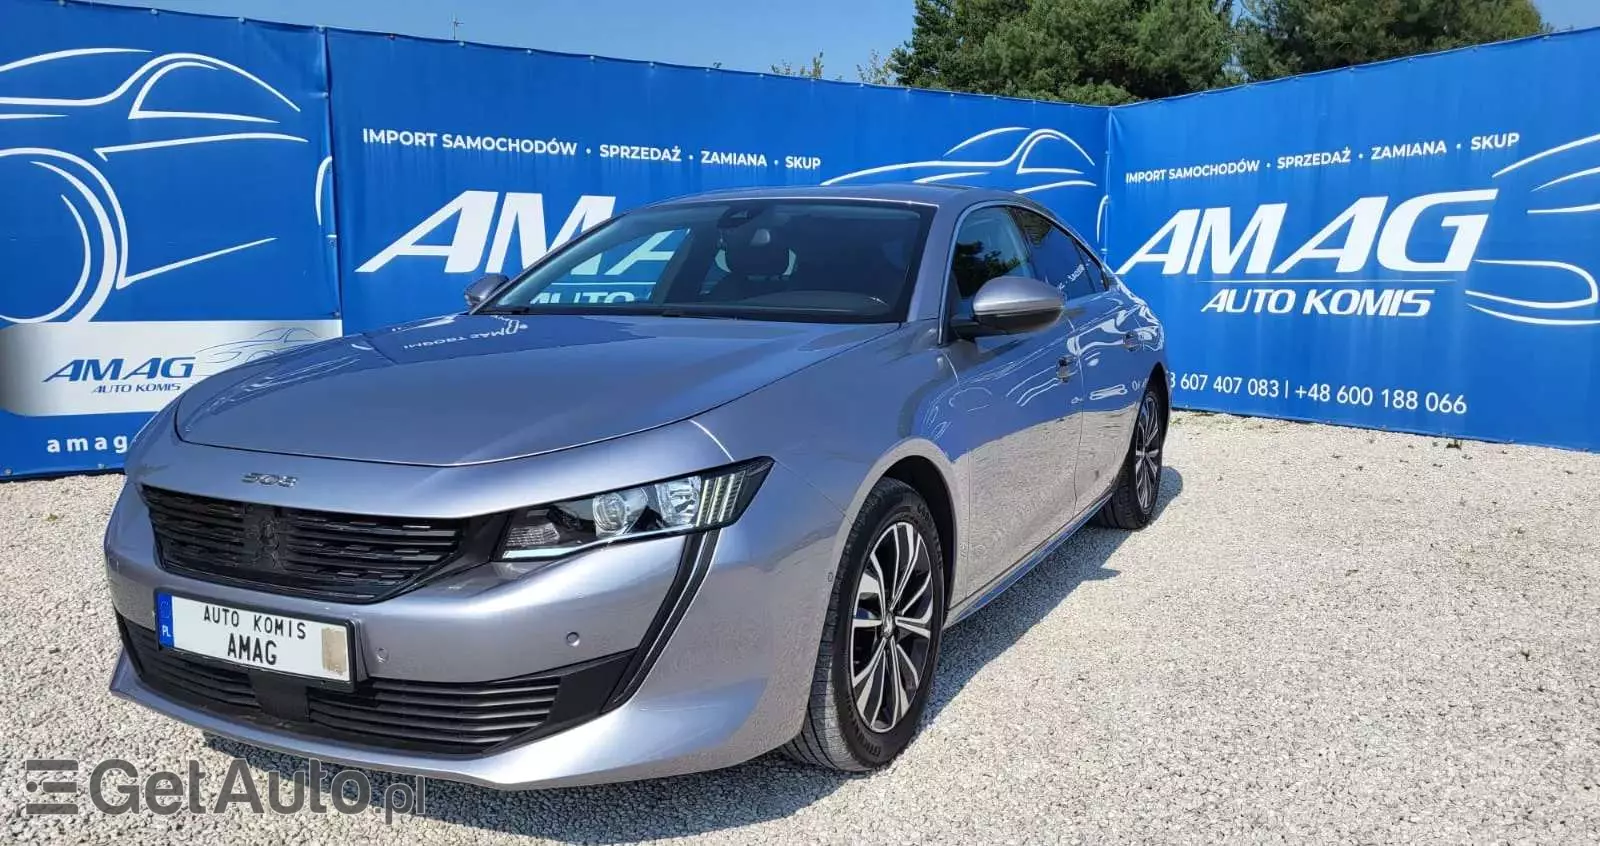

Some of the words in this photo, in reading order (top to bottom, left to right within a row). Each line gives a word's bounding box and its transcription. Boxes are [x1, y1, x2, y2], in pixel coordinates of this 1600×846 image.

[363, 128, 437, 147] IMPORT
[442, 134, 577, 155] SAMOCHODÓW
[599, 144, 682, 162] SPRZEDAŻ
[701, 151, 767, 167] ZAMIANA
[785, 156, 821, 170] SKUP
[1125, 169, 1167, 184] IMPORT
[1168, 159, 1260, 179] SAMOCHODÓW
[1277, 147, 1351, 169] SPRZEDAŻ
[1371, 140, 1447, 160] ZAMIANA
[1470, 132, 1520, 151] SKUP
[1201, 289, 1296, 313] AUTO
[1302, 289, 1436, 317] KOMIS
[92, 384, 132, 393] AUTO
[135, 383, 181, 392] KOMIS
[1180, 373, 1208, 391] 607
[1213, 375, 1242, 394] 407
[1247, 378, 1279, 398] 083
[1295, 383, 1330, 402] +48
[1336, 384, 1373, 406] 600
[1381, 388, 1418, 410] 188
[1425, 392, 1467, 414] 066
[162, 624, 172, 638] PL
[204, 605, 240, 628] AUTO
[254, 615, 306, 640] KOMIS
[227, 633, 277, 666] AMAG
